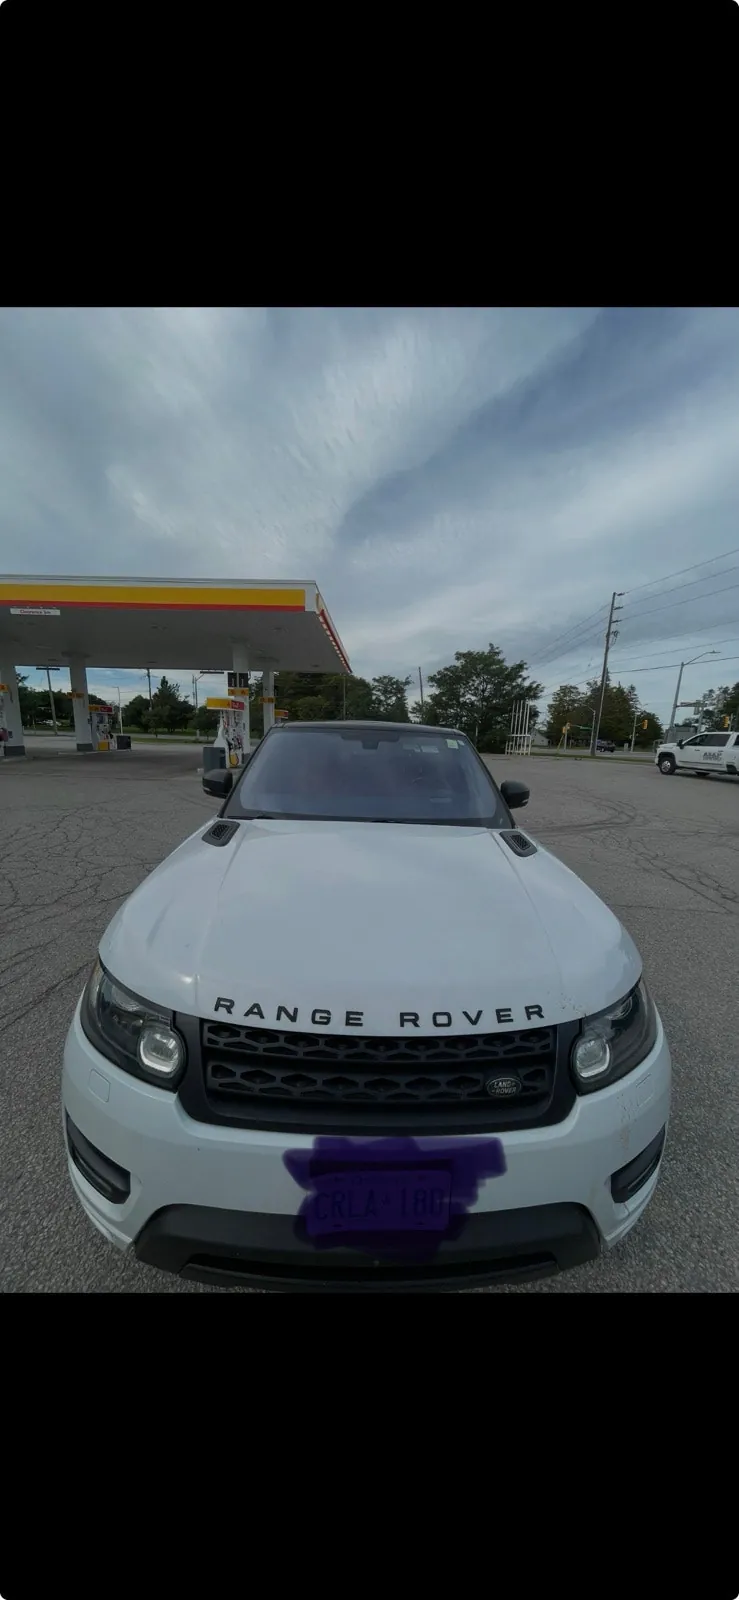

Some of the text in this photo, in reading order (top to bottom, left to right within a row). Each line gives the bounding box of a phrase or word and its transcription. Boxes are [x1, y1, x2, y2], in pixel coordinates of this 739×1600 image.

[213, 996, 545, 1027] RANGE ROVER
[314, 1189, 377, 1220] CRLA
